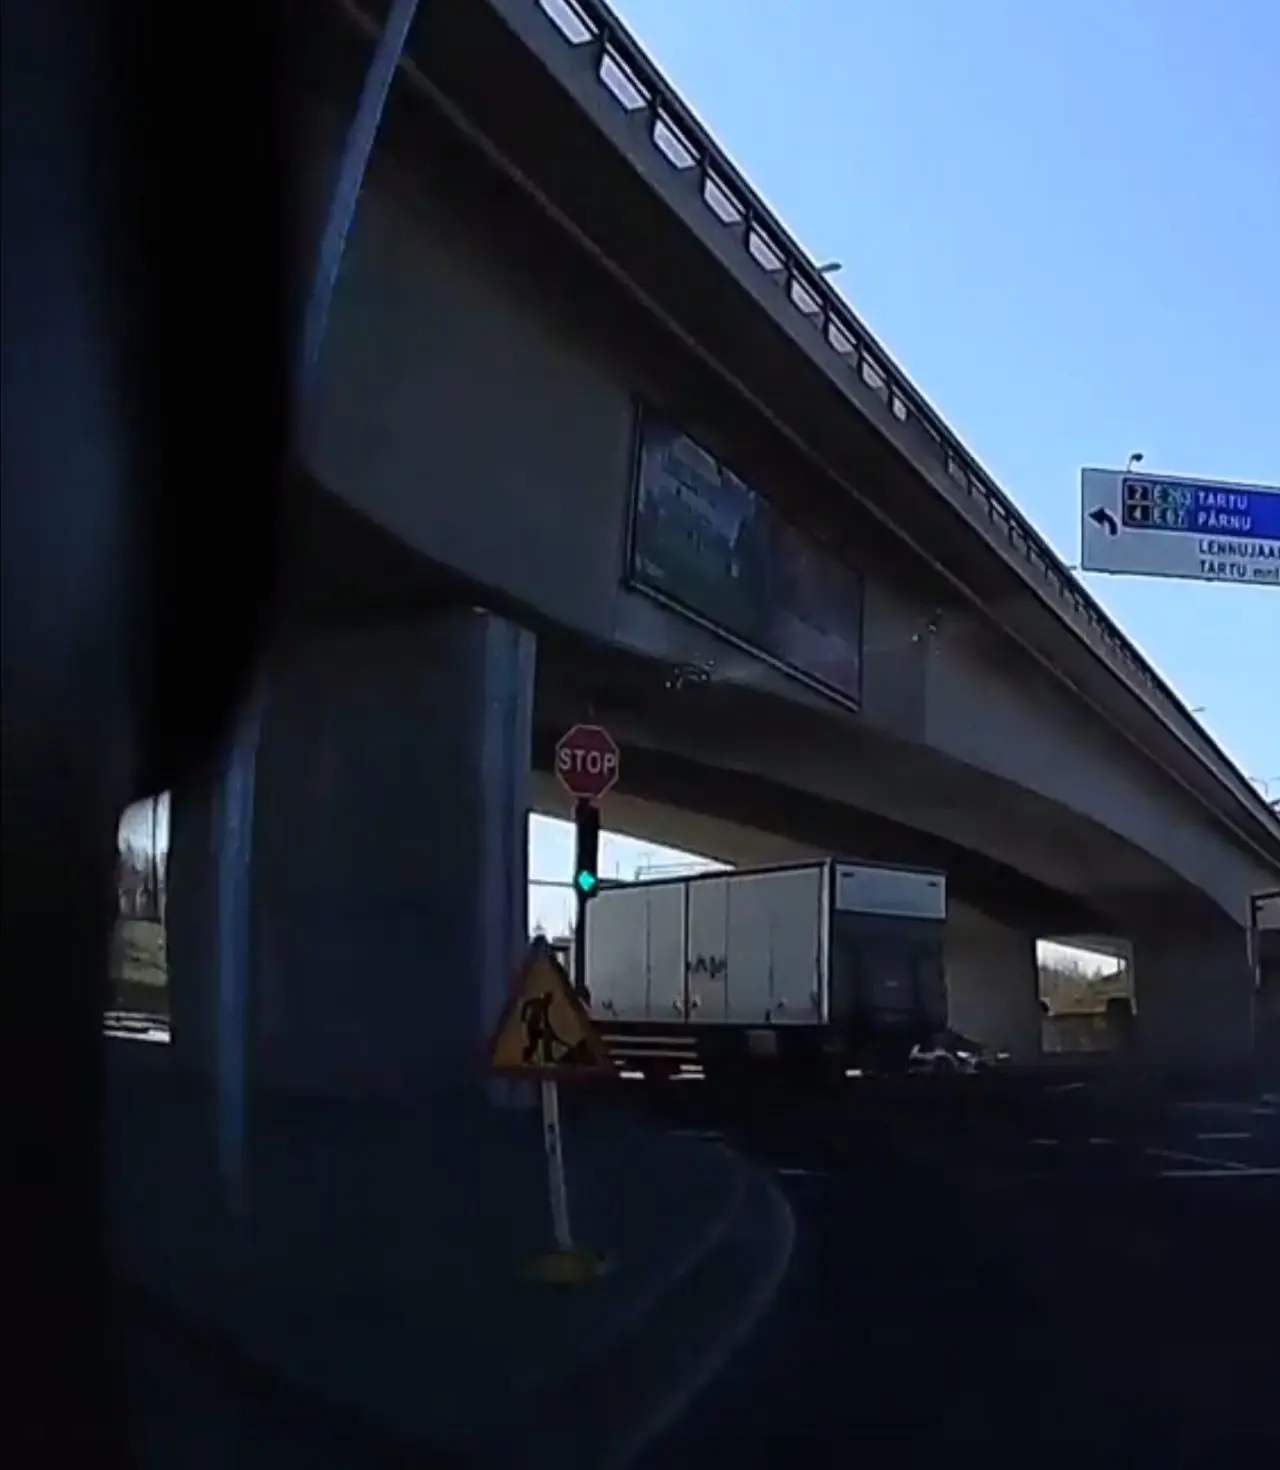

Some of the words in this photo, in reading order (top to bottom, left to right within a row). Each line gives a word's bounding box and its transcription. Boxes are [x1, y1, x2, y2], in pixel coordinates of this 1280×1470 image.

[1199, 490, 1249, 510] TARTU
[1198, 510, 1252, 531] PÄRNU
[1199, 560, 1246, 578] TARTU
[559, 747, 616, 776] STOP
